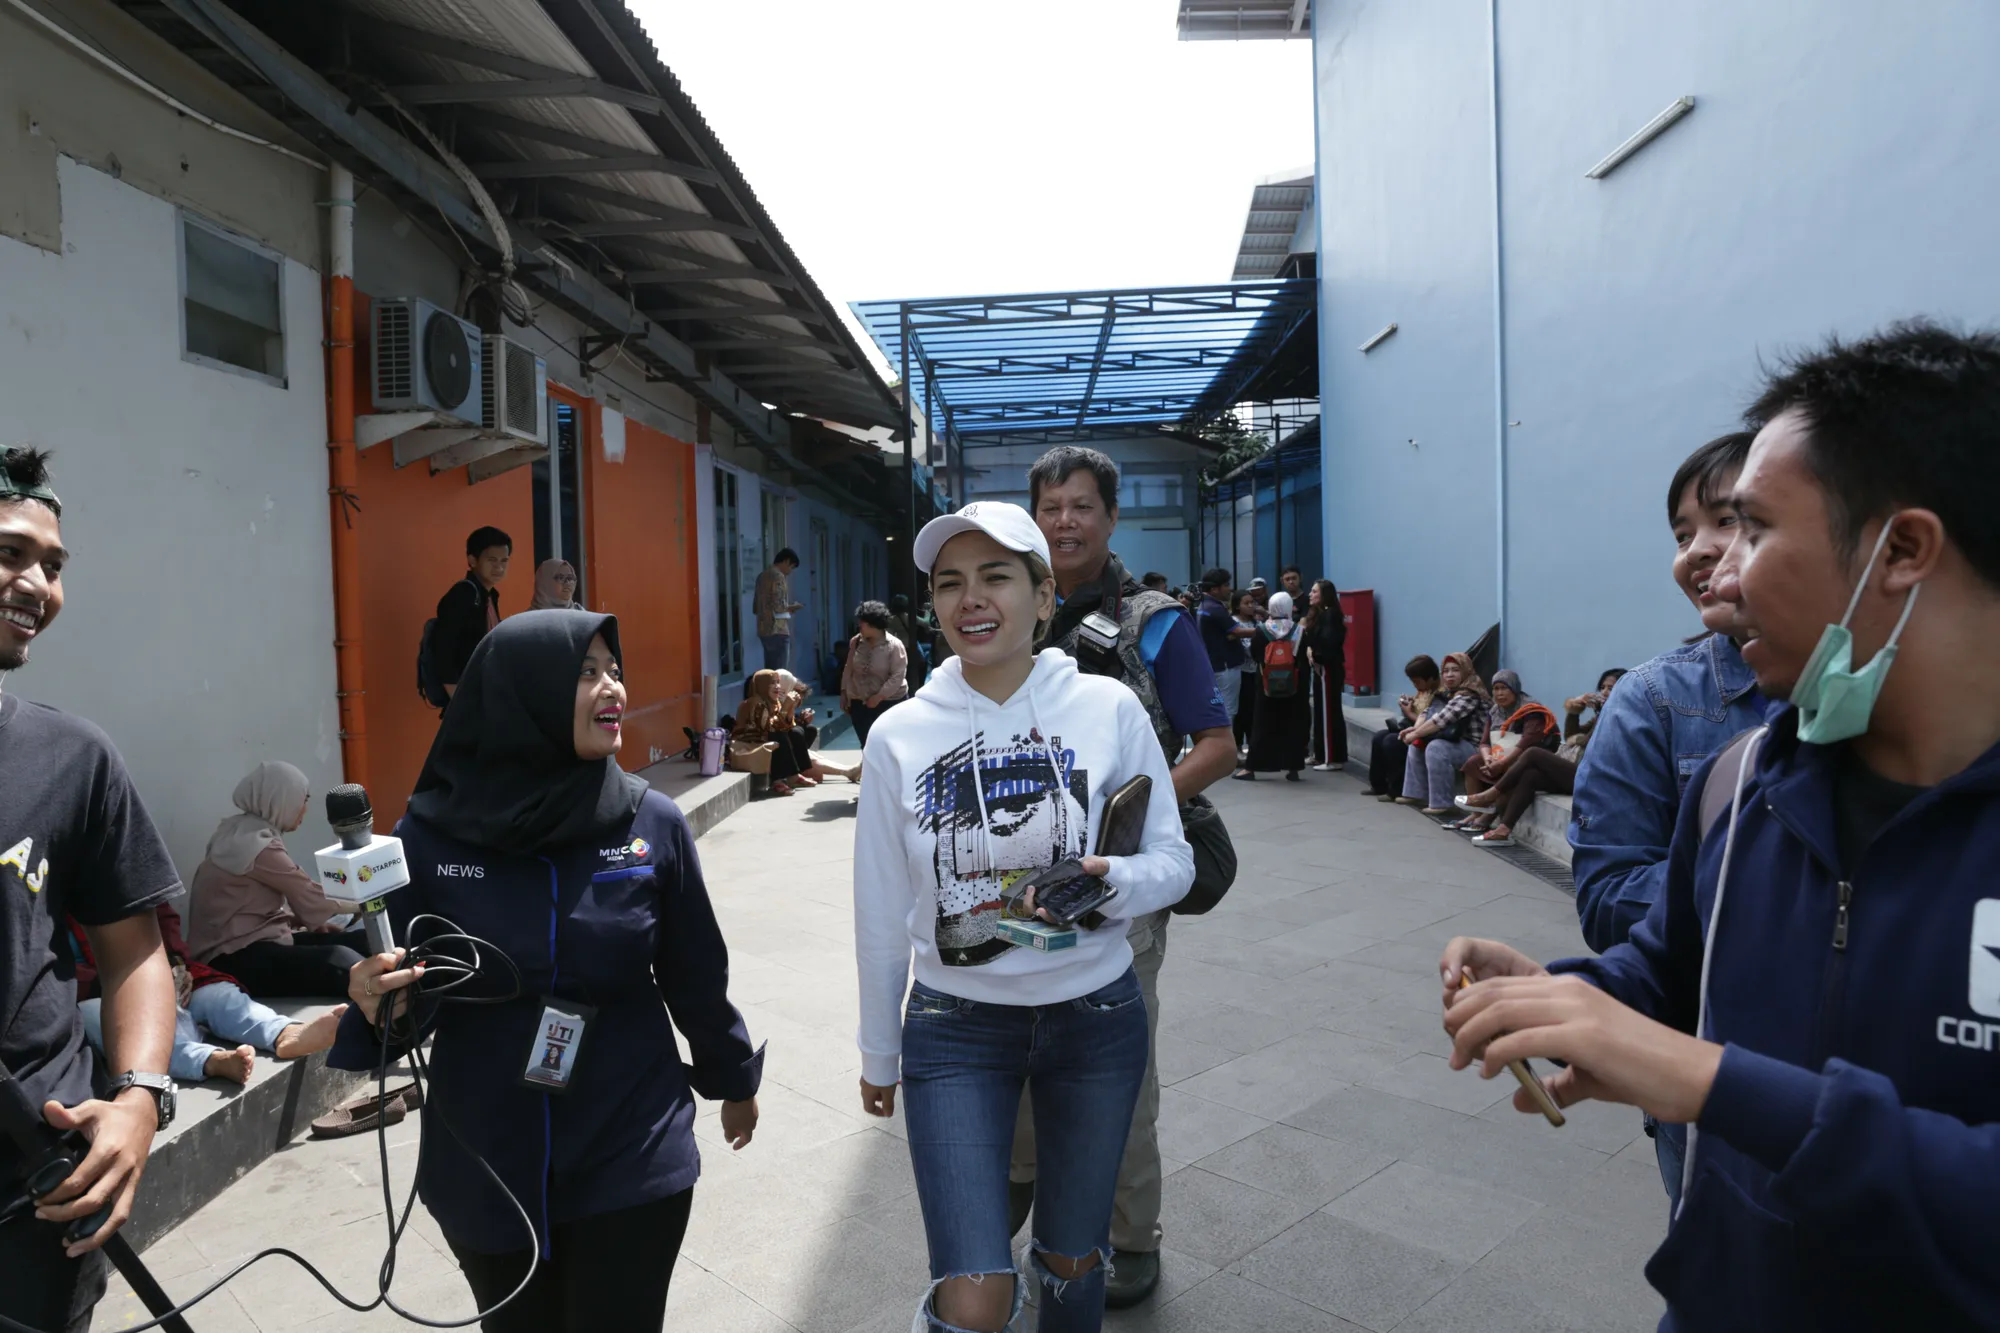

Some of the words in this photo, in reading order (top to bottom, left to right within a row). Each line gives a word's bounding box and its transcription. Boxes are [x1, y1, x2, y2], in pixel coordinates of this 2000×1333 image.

[599, 845, 630, 857] MNC
[372, 857, 402, 874] STARPRO
[437, 863, 485, 879] NEWS
